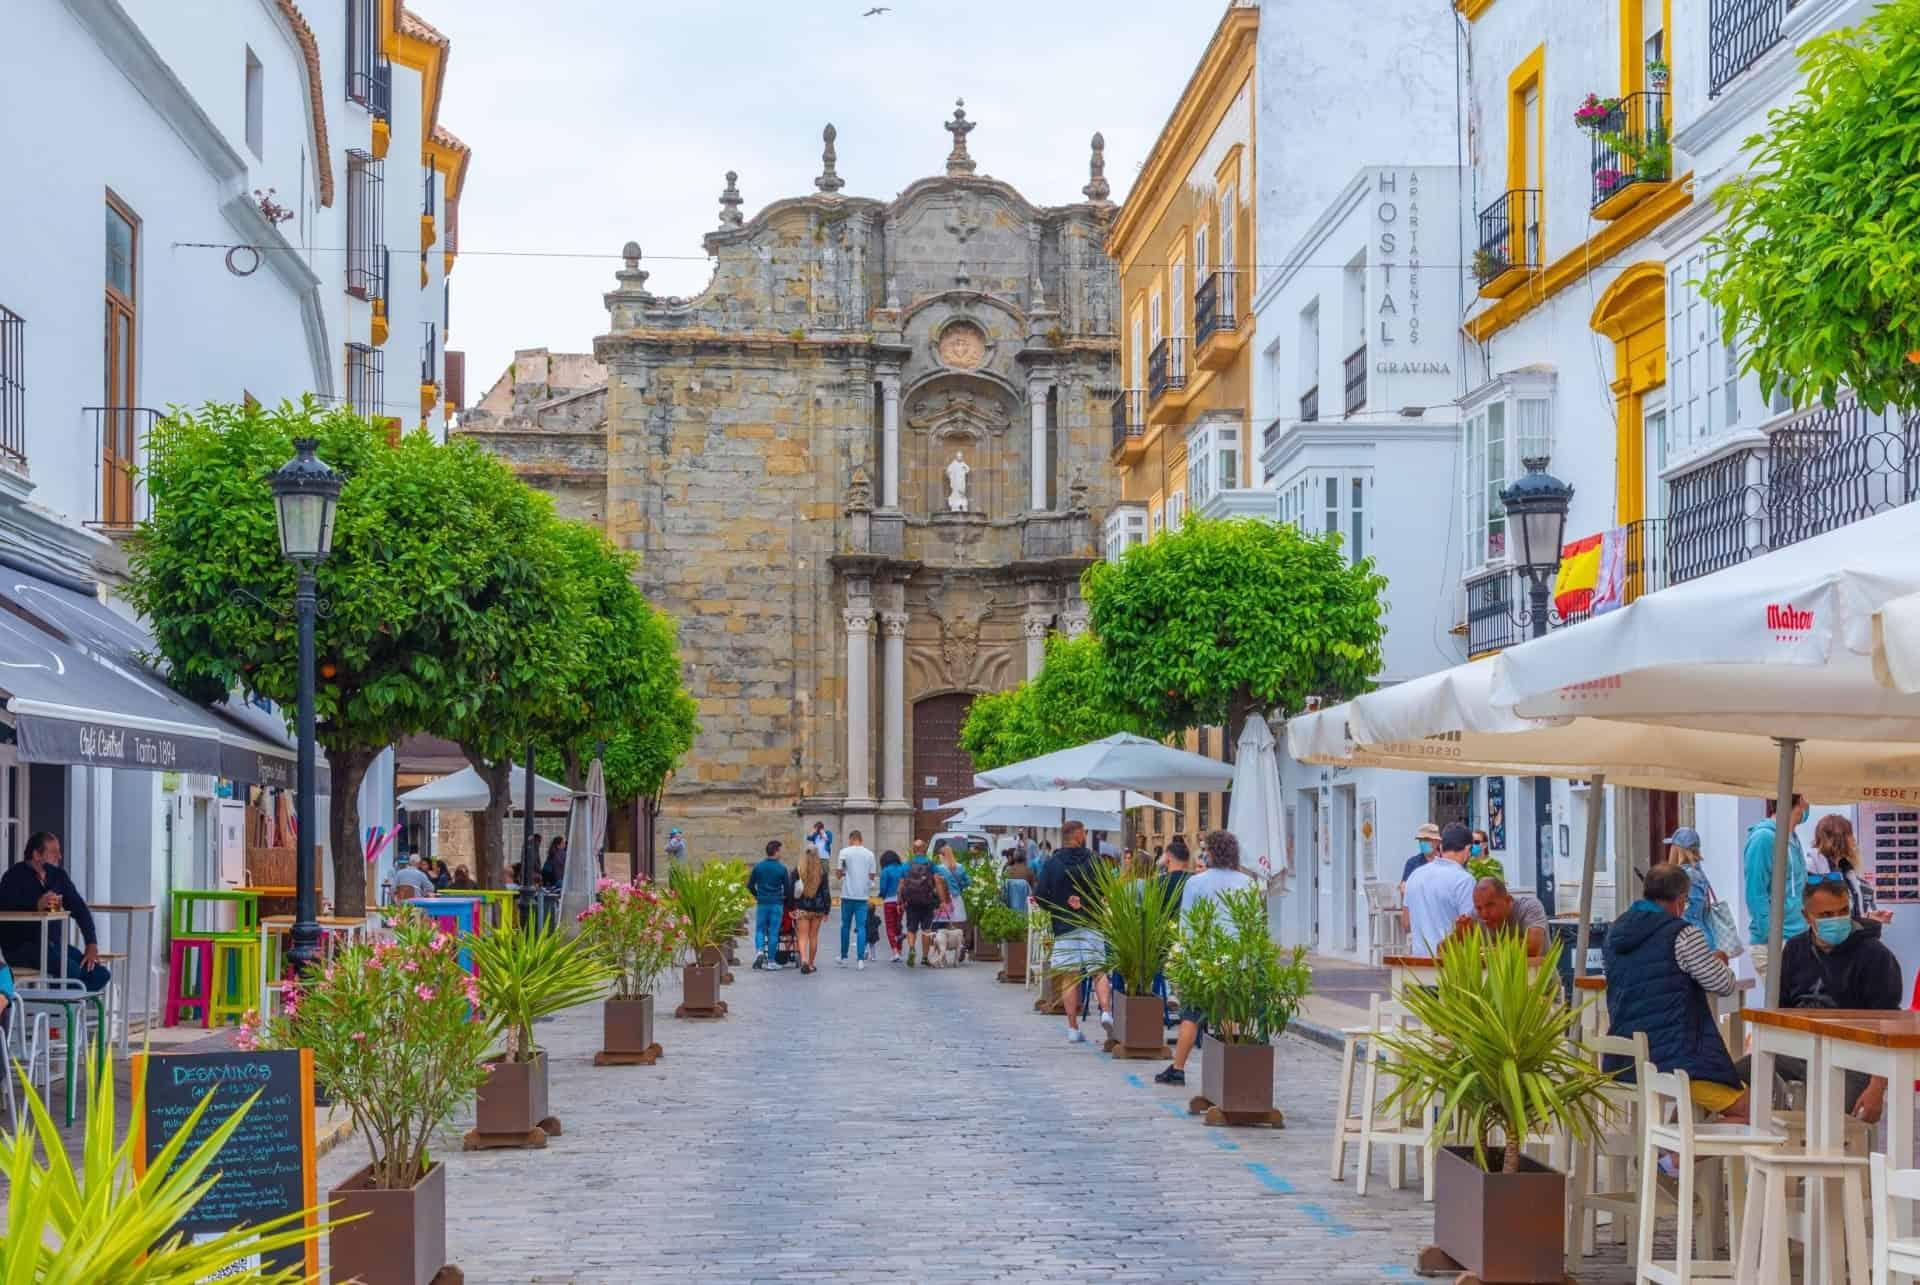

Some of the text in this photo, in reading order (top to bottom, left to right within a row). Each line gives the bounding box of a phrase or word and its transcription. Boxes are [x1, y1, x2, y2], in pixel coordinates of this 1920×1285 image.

[1378, 171, 1397, 342] HOSTAL
[1408, 171, 1419, 345] APARTAMENTOS
[1376, 361, 1451, 375] GRAVINA
[1863, 787, 1906, 800] DESDE
